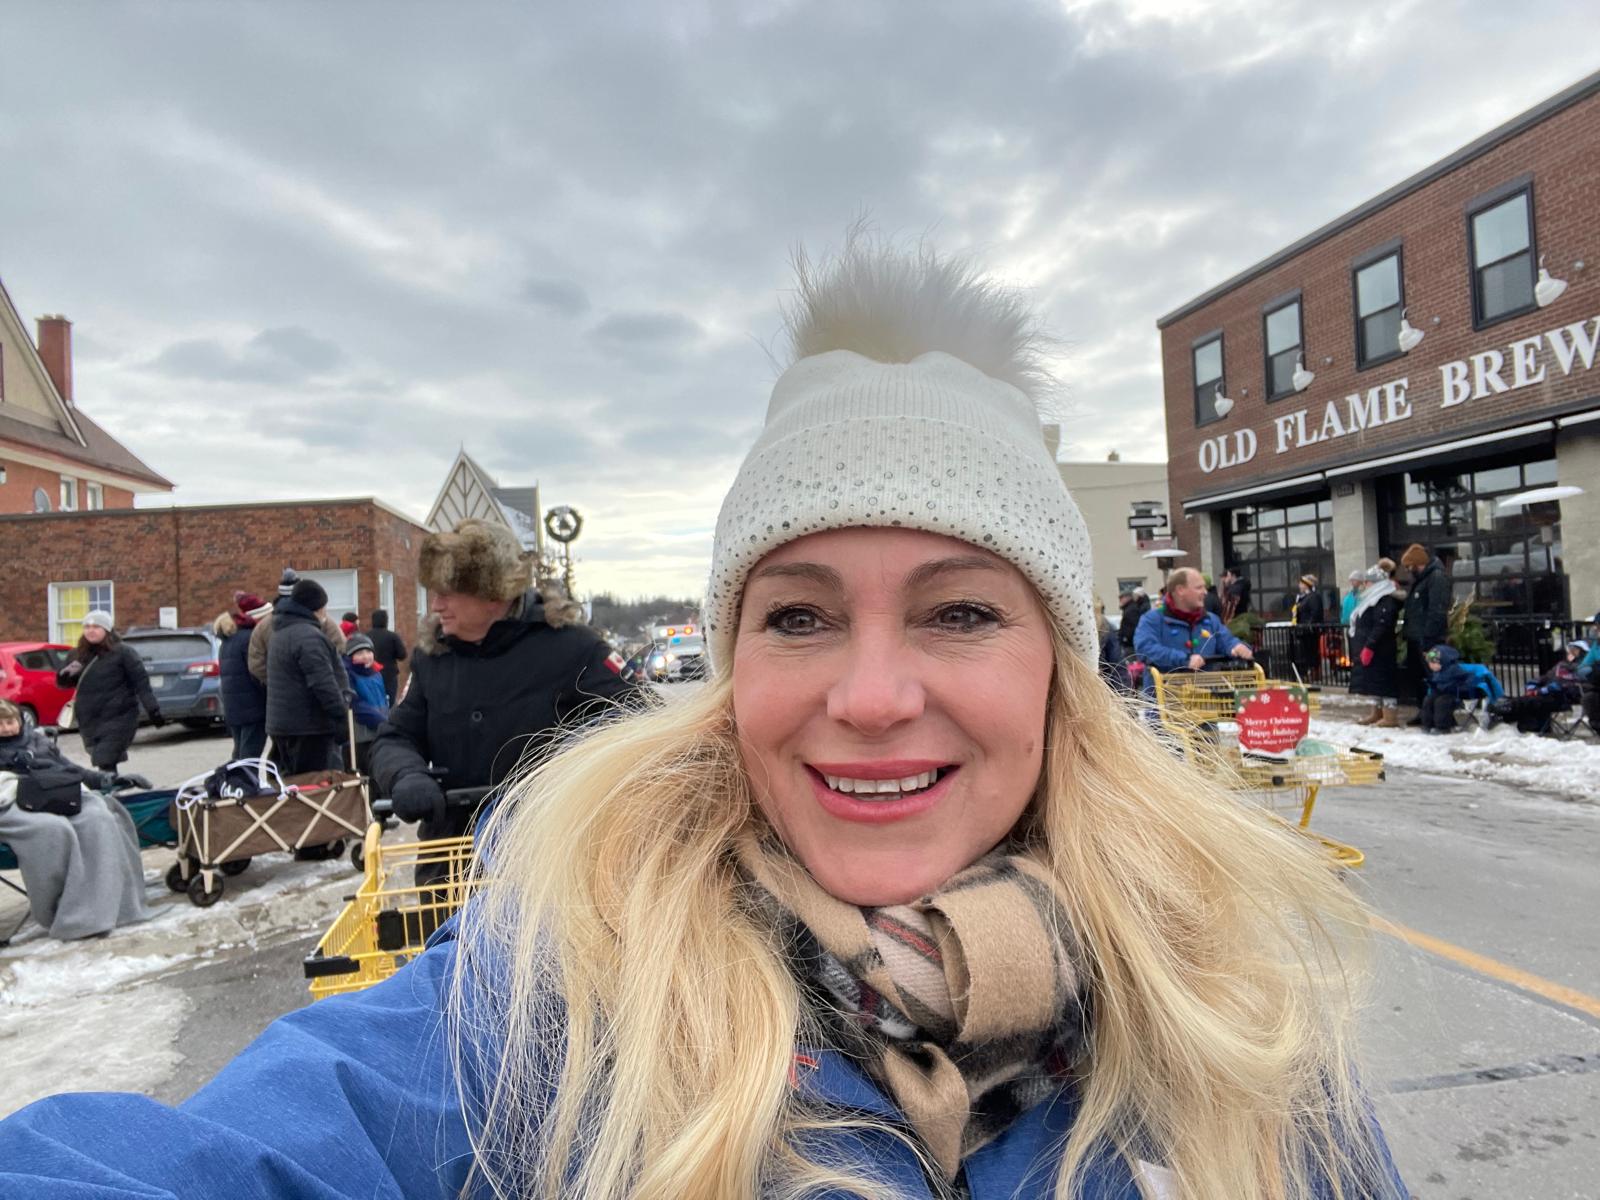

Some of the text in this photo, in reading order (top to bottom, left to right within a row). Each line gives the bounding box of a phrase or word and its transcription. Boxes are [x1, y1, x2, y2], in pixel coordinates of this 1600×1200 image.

[1199, 315, 1600, 473] OLD FLAME BREW
[1244, 717, 1302, 728] Merry Christmas
[1247, 729, 1271, 739] Happy
